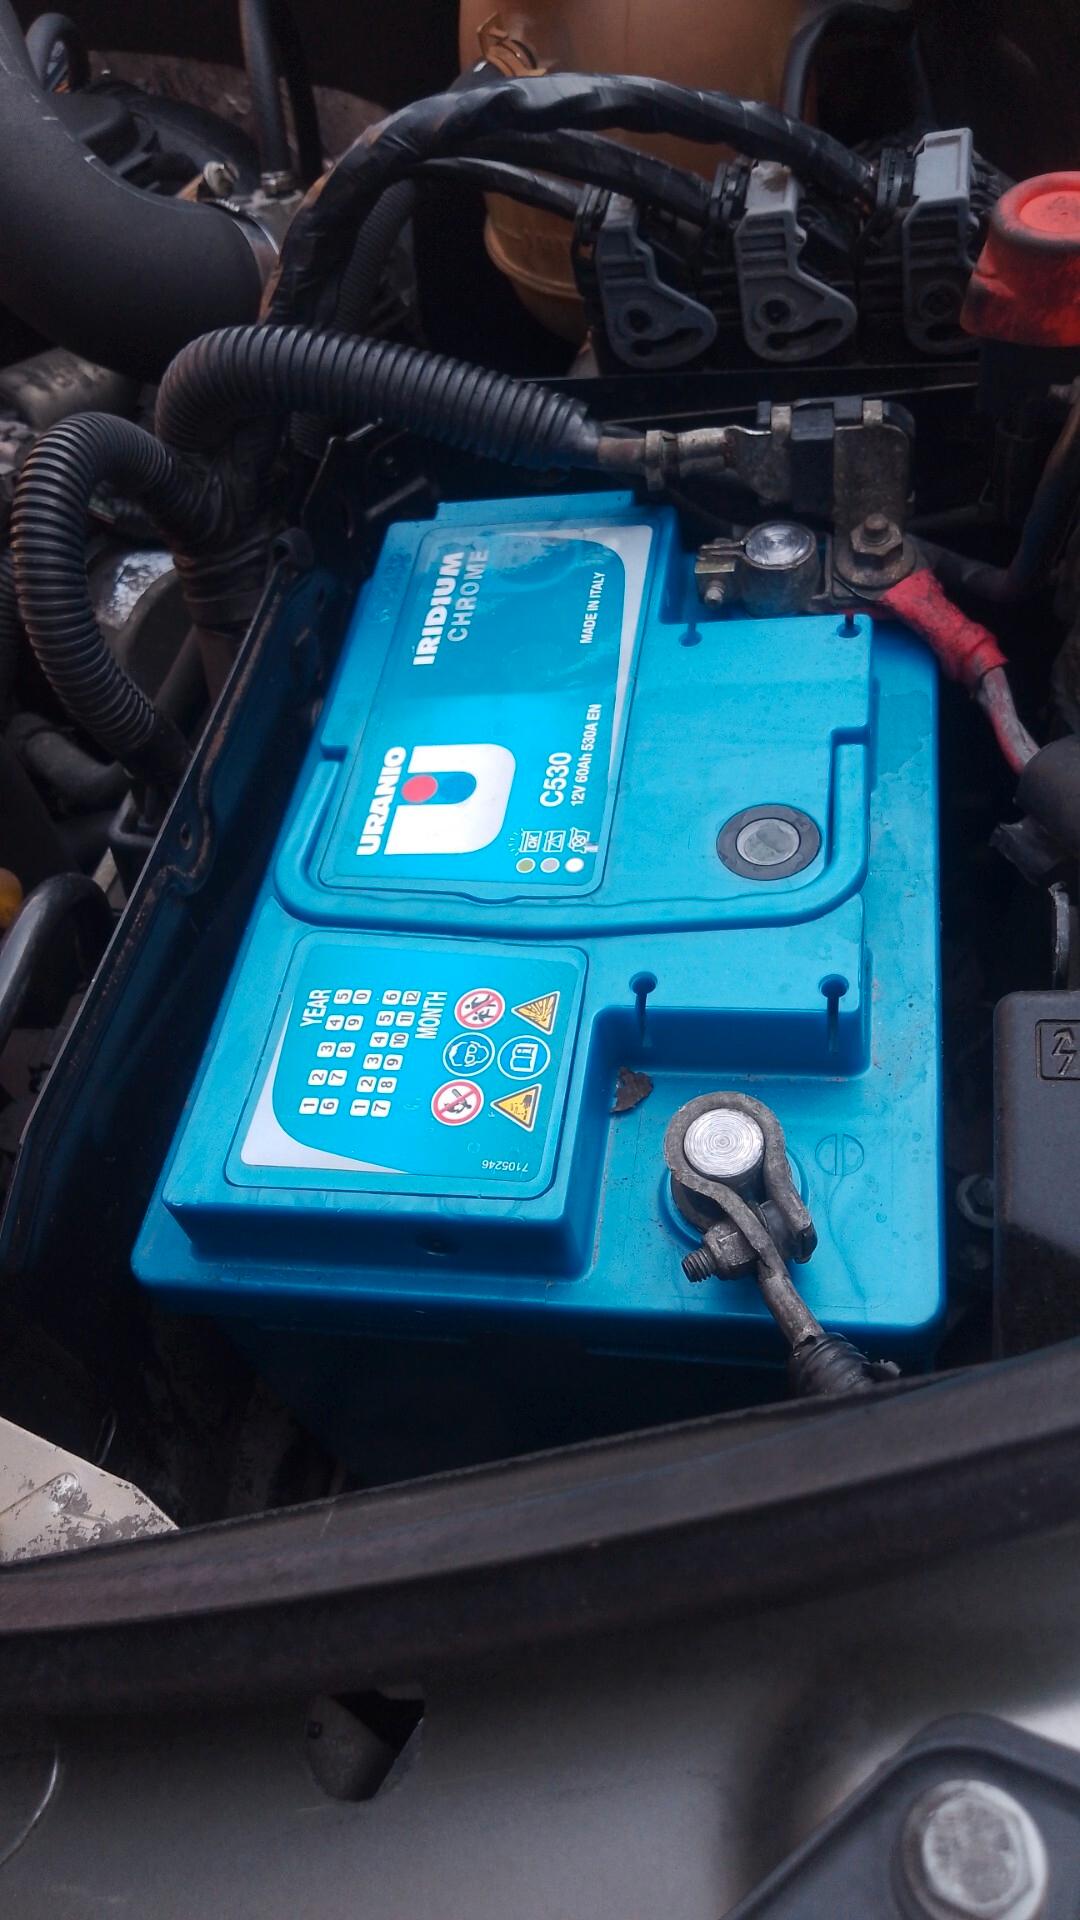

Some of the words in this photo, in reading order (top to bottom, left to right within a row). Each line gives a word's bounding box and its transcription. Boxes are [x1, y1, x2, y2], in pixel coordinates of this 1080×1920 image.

[447, 549, 489, 642] CHROME
[589, 571, 606, 599] ITALY
[412, 551, 465, 666] IRIDIUM
[586, 600, 601, 612] IN
[579, 612, 598, 645] MADE
[586, 703, 603, 721] EN
[580, 721, 599, 752] 530A
[539, 751, 572, 808] C530
[574, 753, 593, 784] 60Ah
[355, 746, 407, 856] URANIO
[570, 784, 586, 807] 12V
[299, 989, 333, 1027] YEAR
[415, 991, 448, 1039] MONTH
[481, 1159, 529, 1173] 7105246
